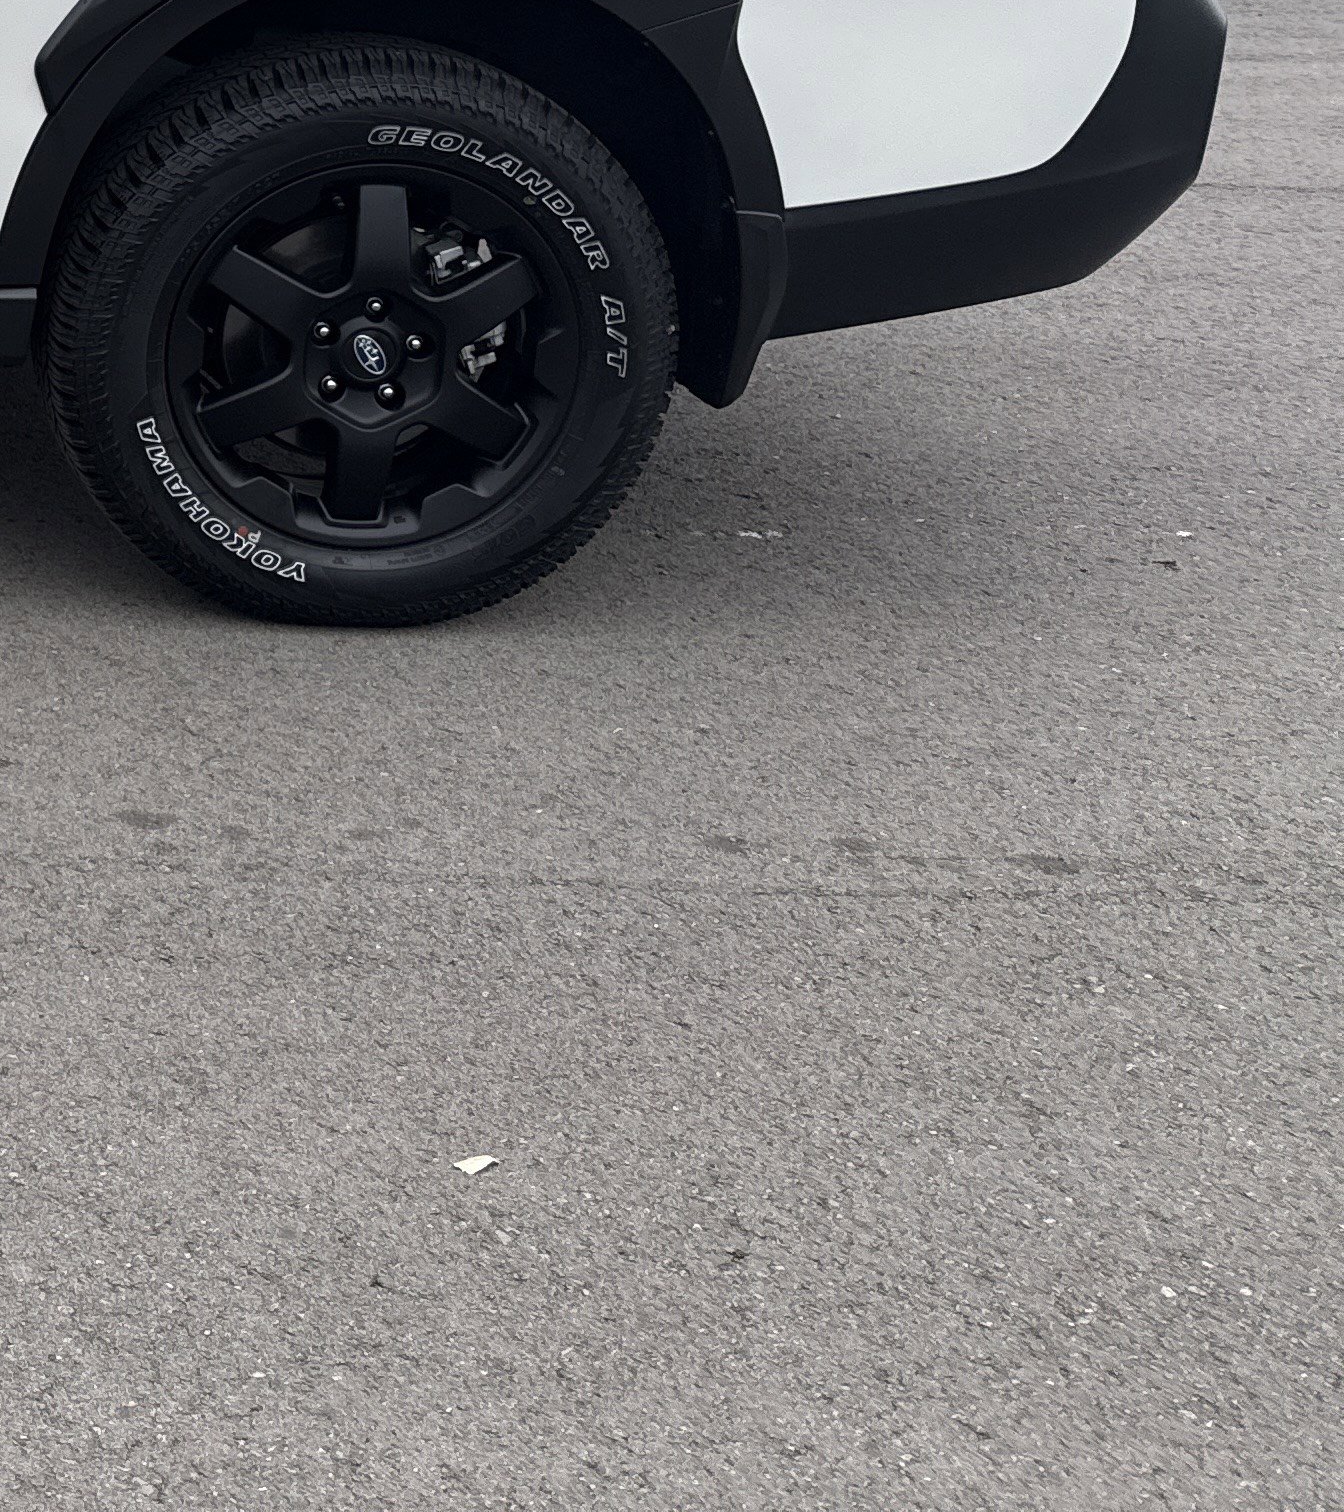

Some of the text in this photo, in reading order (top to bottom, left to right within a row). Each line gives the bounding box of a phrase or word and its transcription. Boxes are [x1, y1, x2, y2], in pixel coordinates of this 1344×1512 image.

[367, 125, 628, 378] GEOLANDAR A/T
[136, 417, 306, 583] YOKOHAMA
